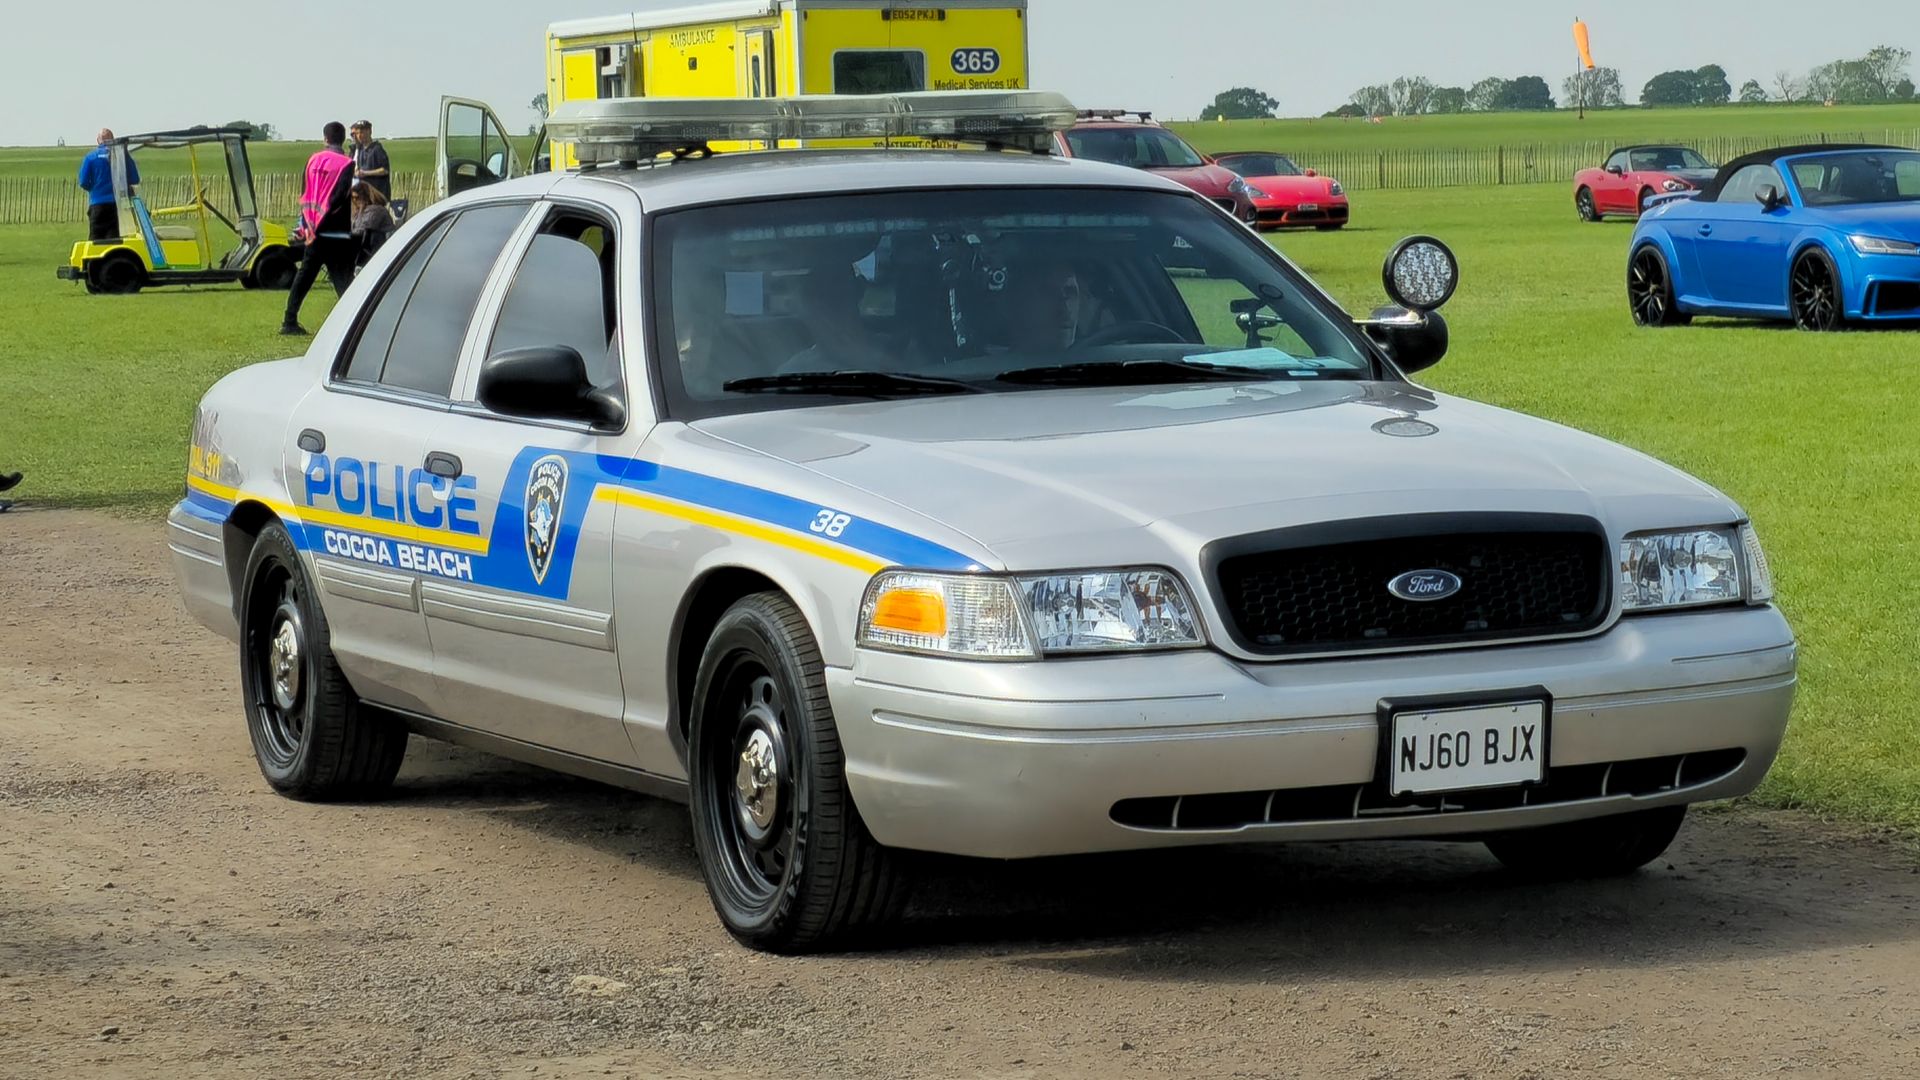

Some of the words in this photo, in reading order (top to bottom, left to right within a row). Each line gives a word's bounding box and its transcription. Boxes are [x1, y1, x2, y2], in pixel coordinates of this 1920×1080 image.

[669, 29, 715, 47] AMBULANCE
[954, 51, 995, 71] 365
[934, 79, 967, 90] Medical
[968, 78, 1004, 90] Services
[1006, 78, 1020, 89] UK
[537, 463, 562, 482] POLICE
[305, 453, 481, 536] POLICE
[809, 508, 852, 538] 38
[324, 530, 394, 566] COCOA
[396, 543, 474, 582] BEACH
[1407, 575, 1445, 594] Ford
[1400, 730, 1471, 773] NJ60
[1484, 724, 1536, 766] BJX
